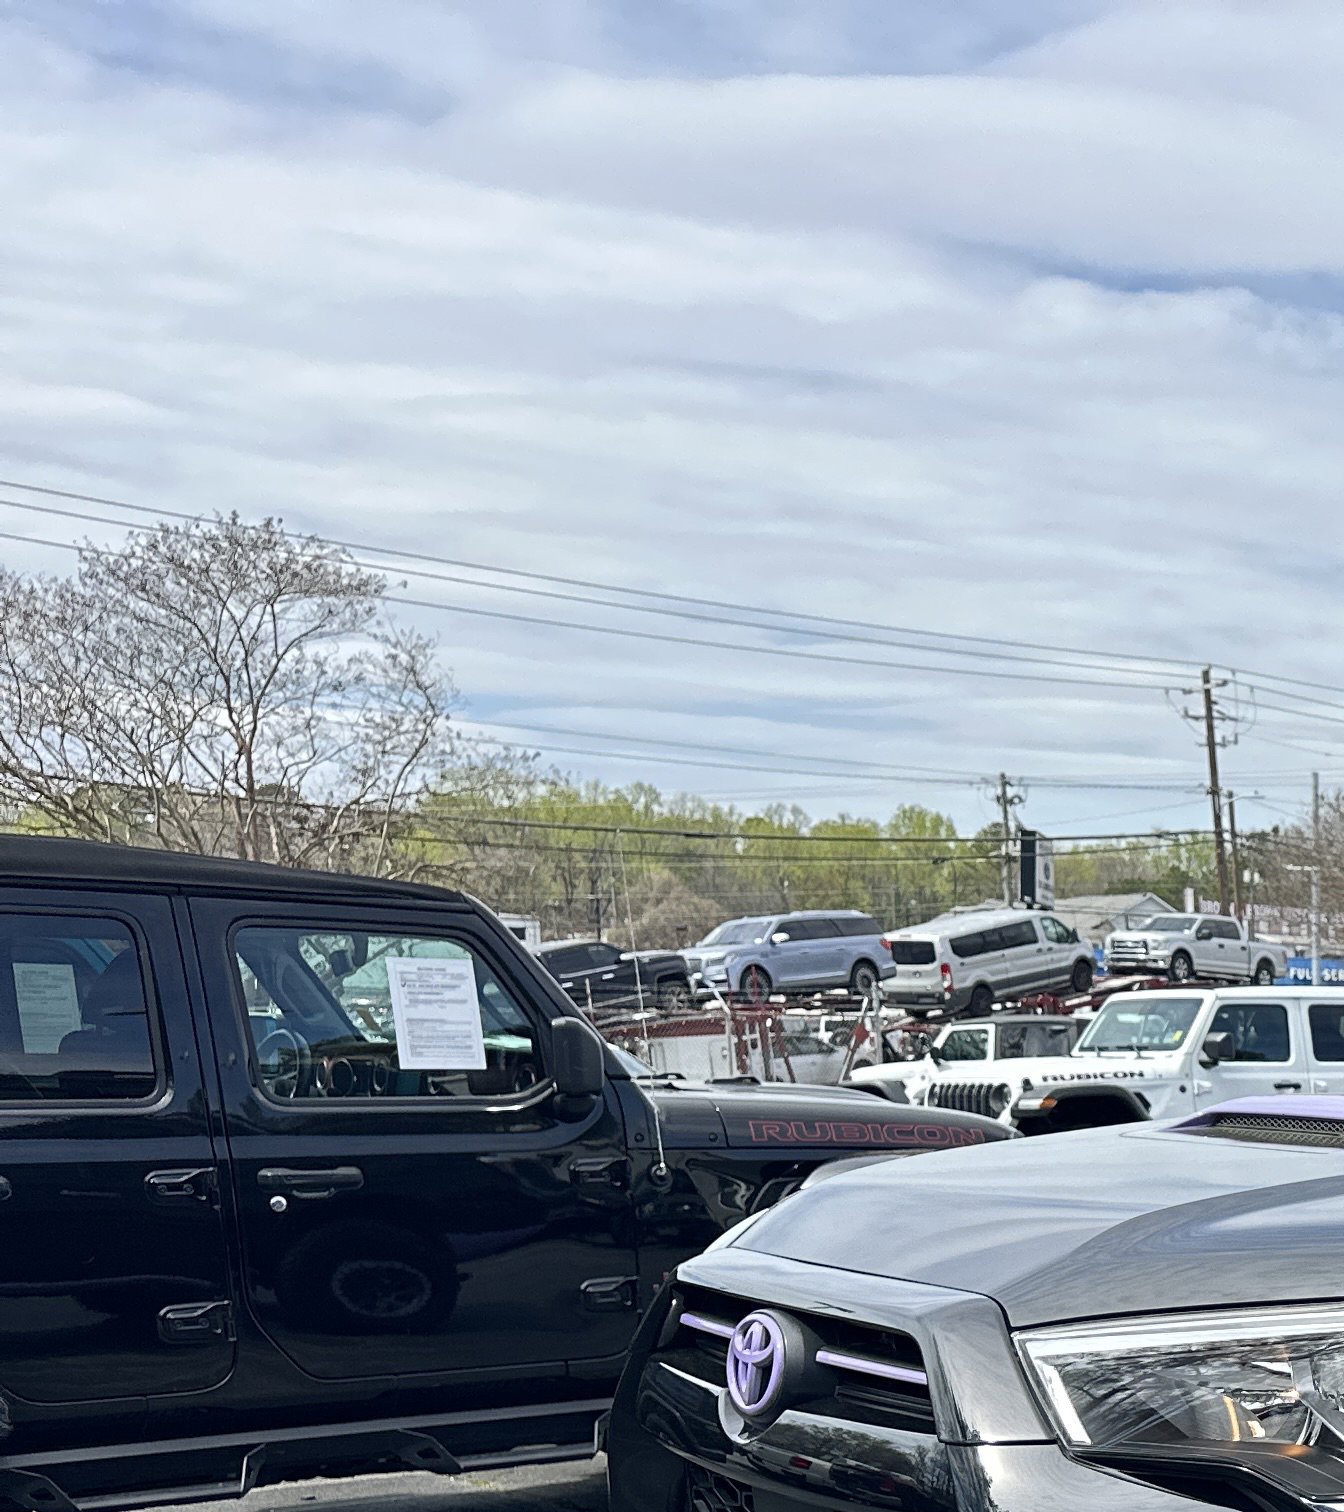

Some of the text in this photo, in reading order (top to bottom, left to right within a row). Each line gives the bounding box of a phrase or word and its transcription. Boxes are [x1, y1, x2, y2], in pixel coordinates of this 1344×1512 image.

[1290, 966, 1317, 981] FUL
[1042, 1071, 1144, 1081] RUBICON
[749, 1120, 985, 1146] RUBICON
